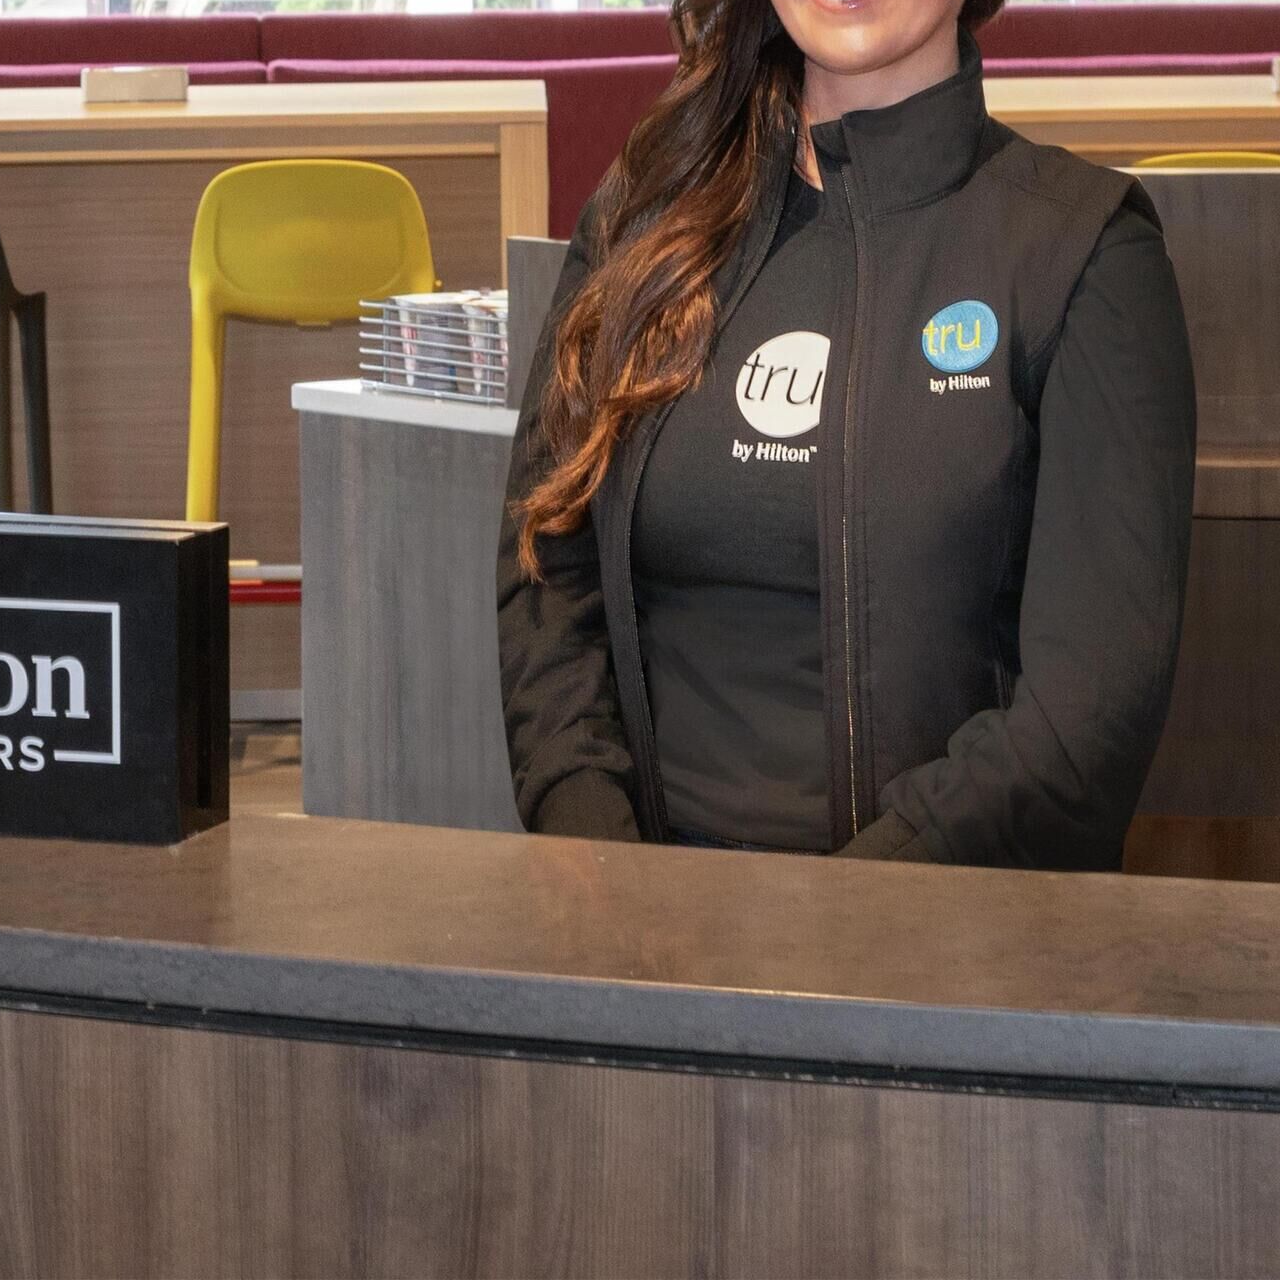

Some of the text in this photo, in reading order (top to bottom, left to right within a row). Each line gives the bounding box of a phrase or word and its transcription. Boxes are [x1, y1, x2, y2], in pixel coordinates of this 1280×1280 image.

[923, 319, 981, 356] tru
[744, 353, 823, 405] tru
[929, 375, 991, 395] by Hilton
[731, 439, 754, 463] by
